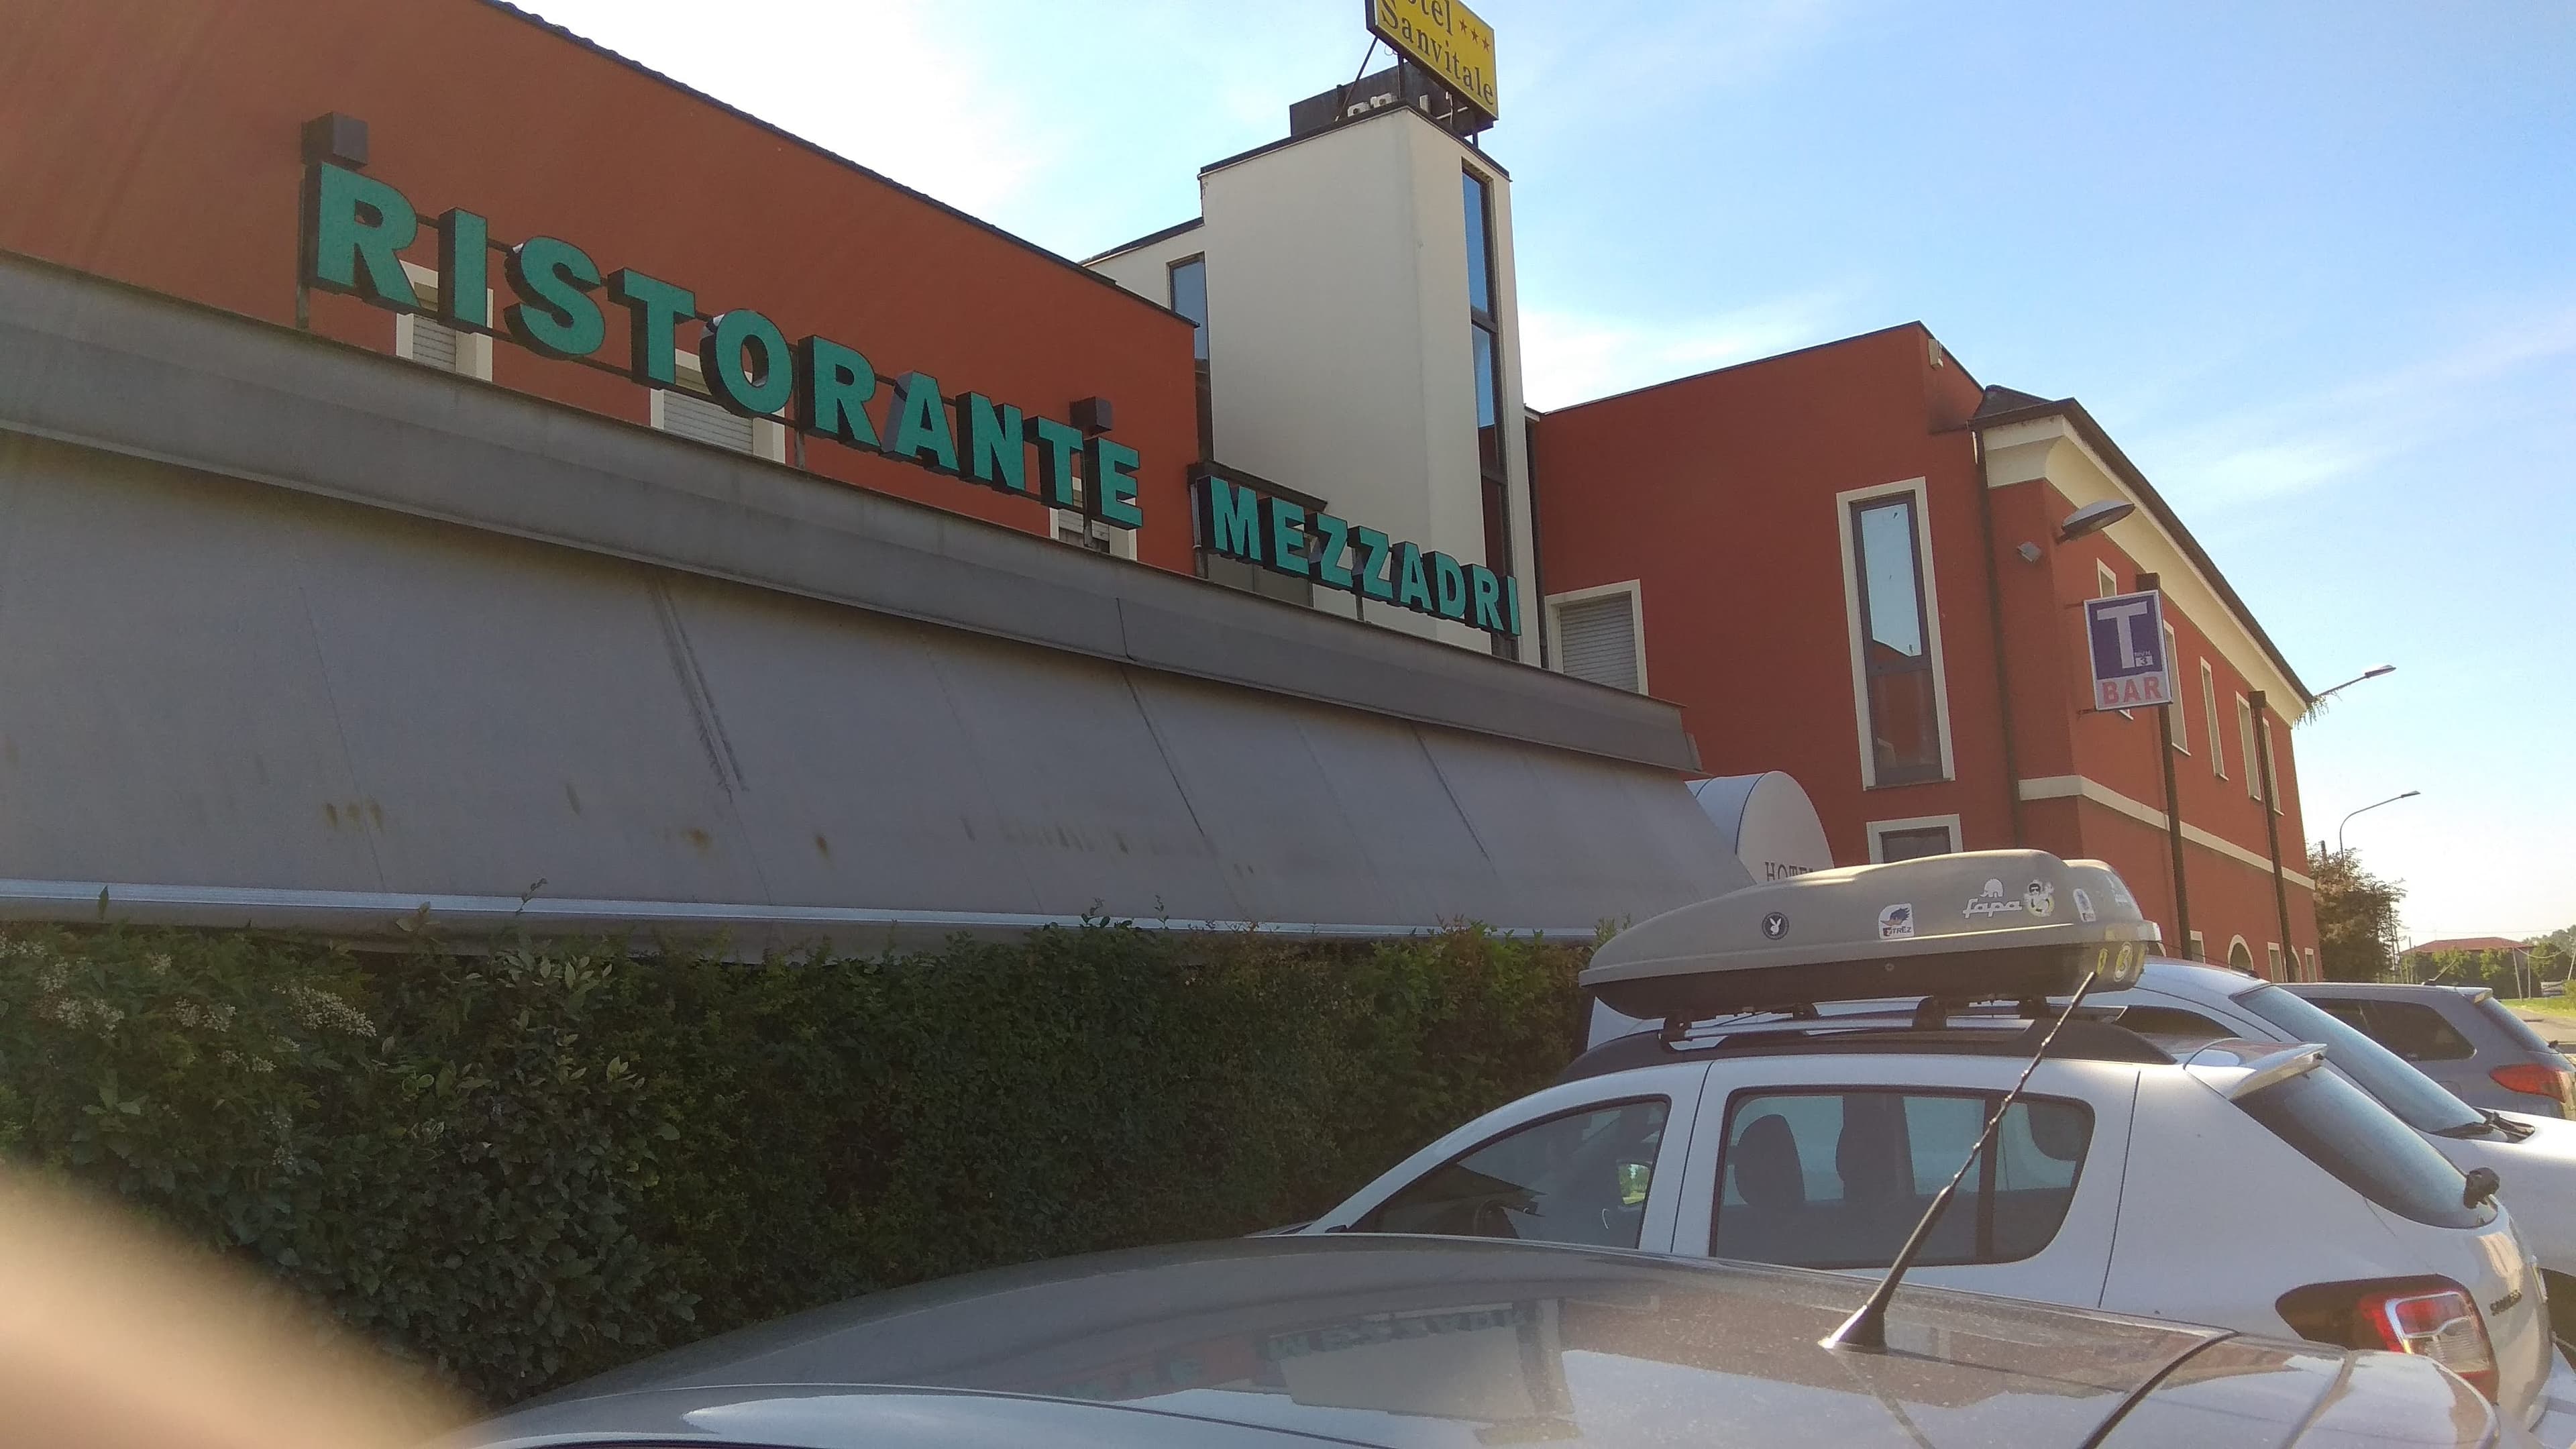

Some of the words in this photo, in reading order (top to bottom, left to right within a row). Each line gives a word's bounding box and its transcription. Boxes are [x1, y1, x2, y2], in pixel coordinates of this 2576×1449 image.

[1381, 0, 1493, 105] Sanvitale
[317, 162, 1142, 529] RISTORANTE
[1210, 475, 1521, 636] MEZZADRI
[2097, 601, 2148, 669] T
[2102, 676, 2163, 706] BAR
